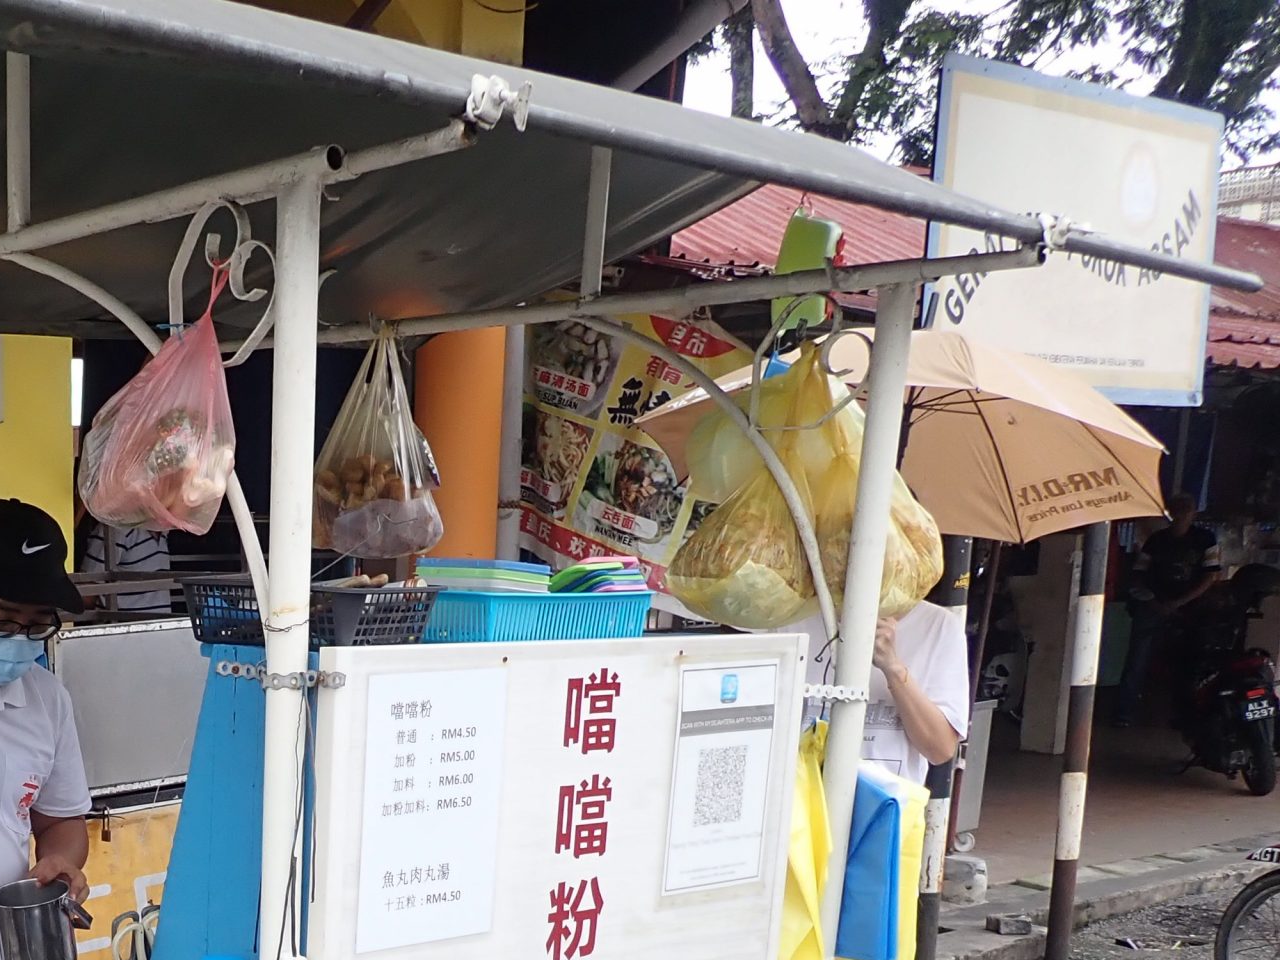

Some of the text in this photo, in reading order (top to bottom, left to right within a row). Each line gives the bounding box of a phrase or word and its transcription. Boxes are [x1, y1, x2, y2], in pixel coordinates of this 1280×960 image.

[391, 700, 433, 720] 噹噹粉
[1245, 707, 1274, 720] 9297
[396, 729, 417, 744] 普通
[441, 727, 477, 740] RM4.50
[394, 753, 415, 768] 加粉
[440, 750, 475, 763] RM5.00
[393, 776, 414, 792] 加料
[438, 773, 474, 787] RM6.00
[437, 796, 472, 810] RM6.50
[382, 863, 450, 889] 魚丸肉丸湯
[426, 890, 461, 905] RM4.50
